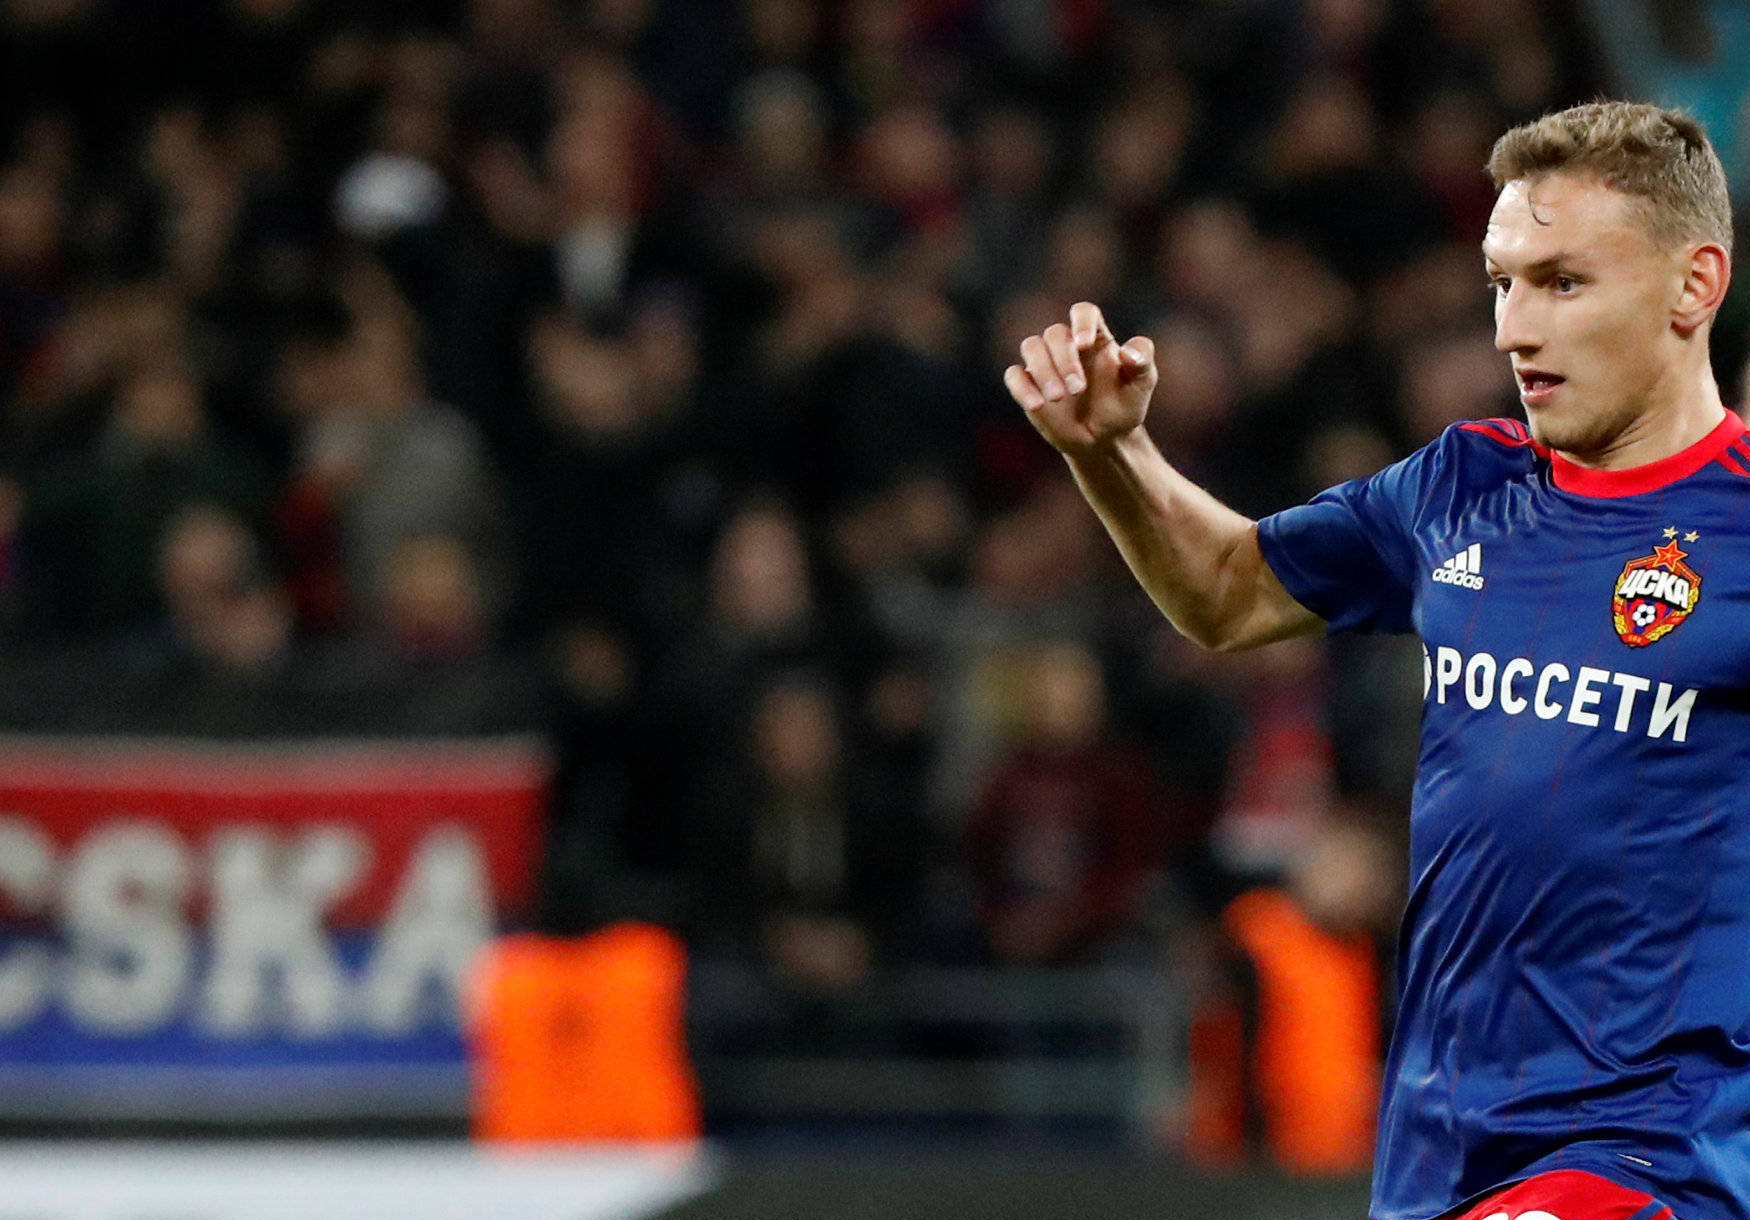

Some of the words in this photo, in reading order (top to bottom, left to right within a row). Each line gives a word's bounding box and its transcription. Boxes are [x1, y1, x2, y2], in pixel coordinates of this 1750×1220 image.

[1432, 567, 1484, 590] adidas
[1618, 568, 1690, 609] ЦСКА
[1437, 646, 1699, 742] РОССЕТИ
